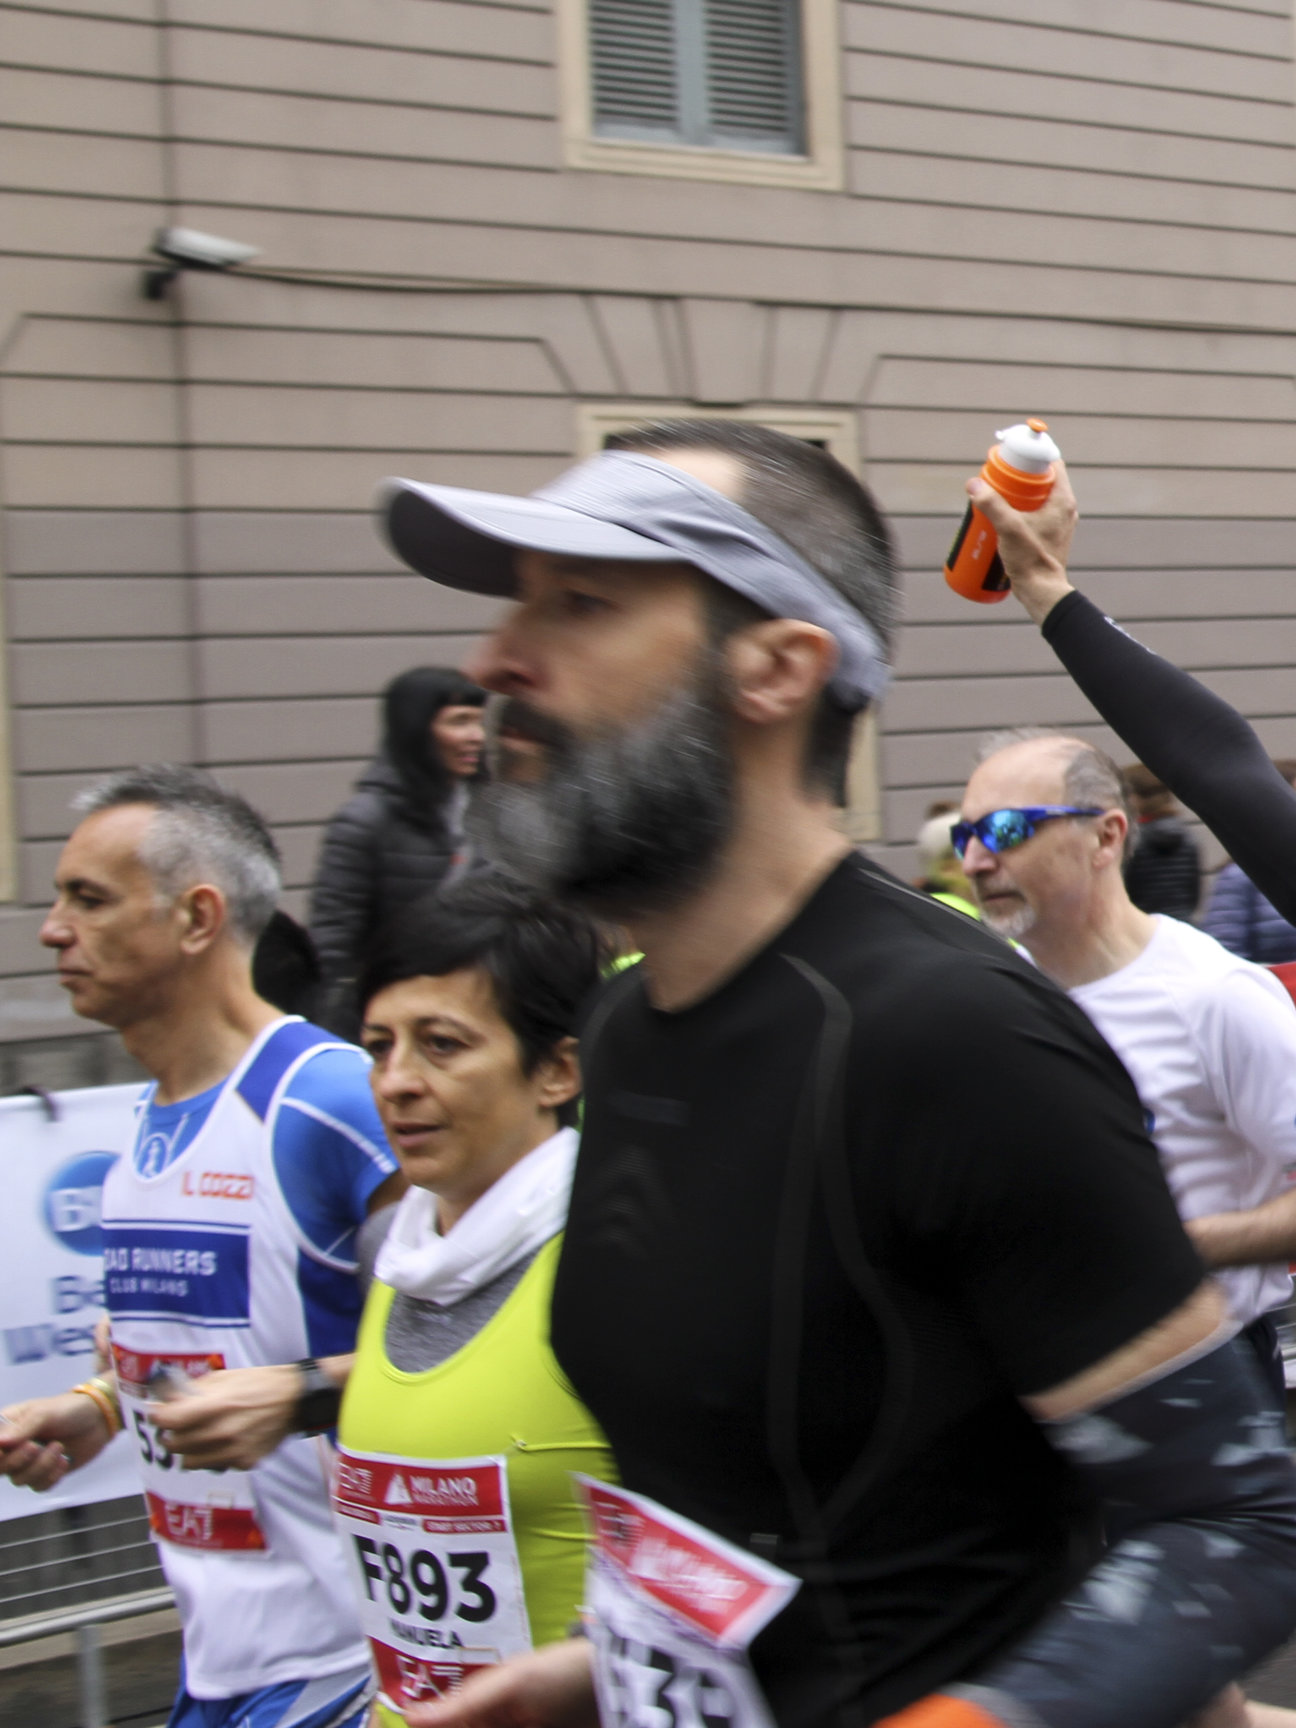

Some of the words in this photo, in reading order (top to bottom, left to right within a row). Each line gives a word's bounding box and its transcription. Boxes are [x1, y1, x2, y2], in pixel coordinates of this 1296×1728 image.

[132, 1248, 217, 1276] RUNNERS
[409, 1475, 477, 1499] MILANO
[352, 1534, 499, 1623] F893
